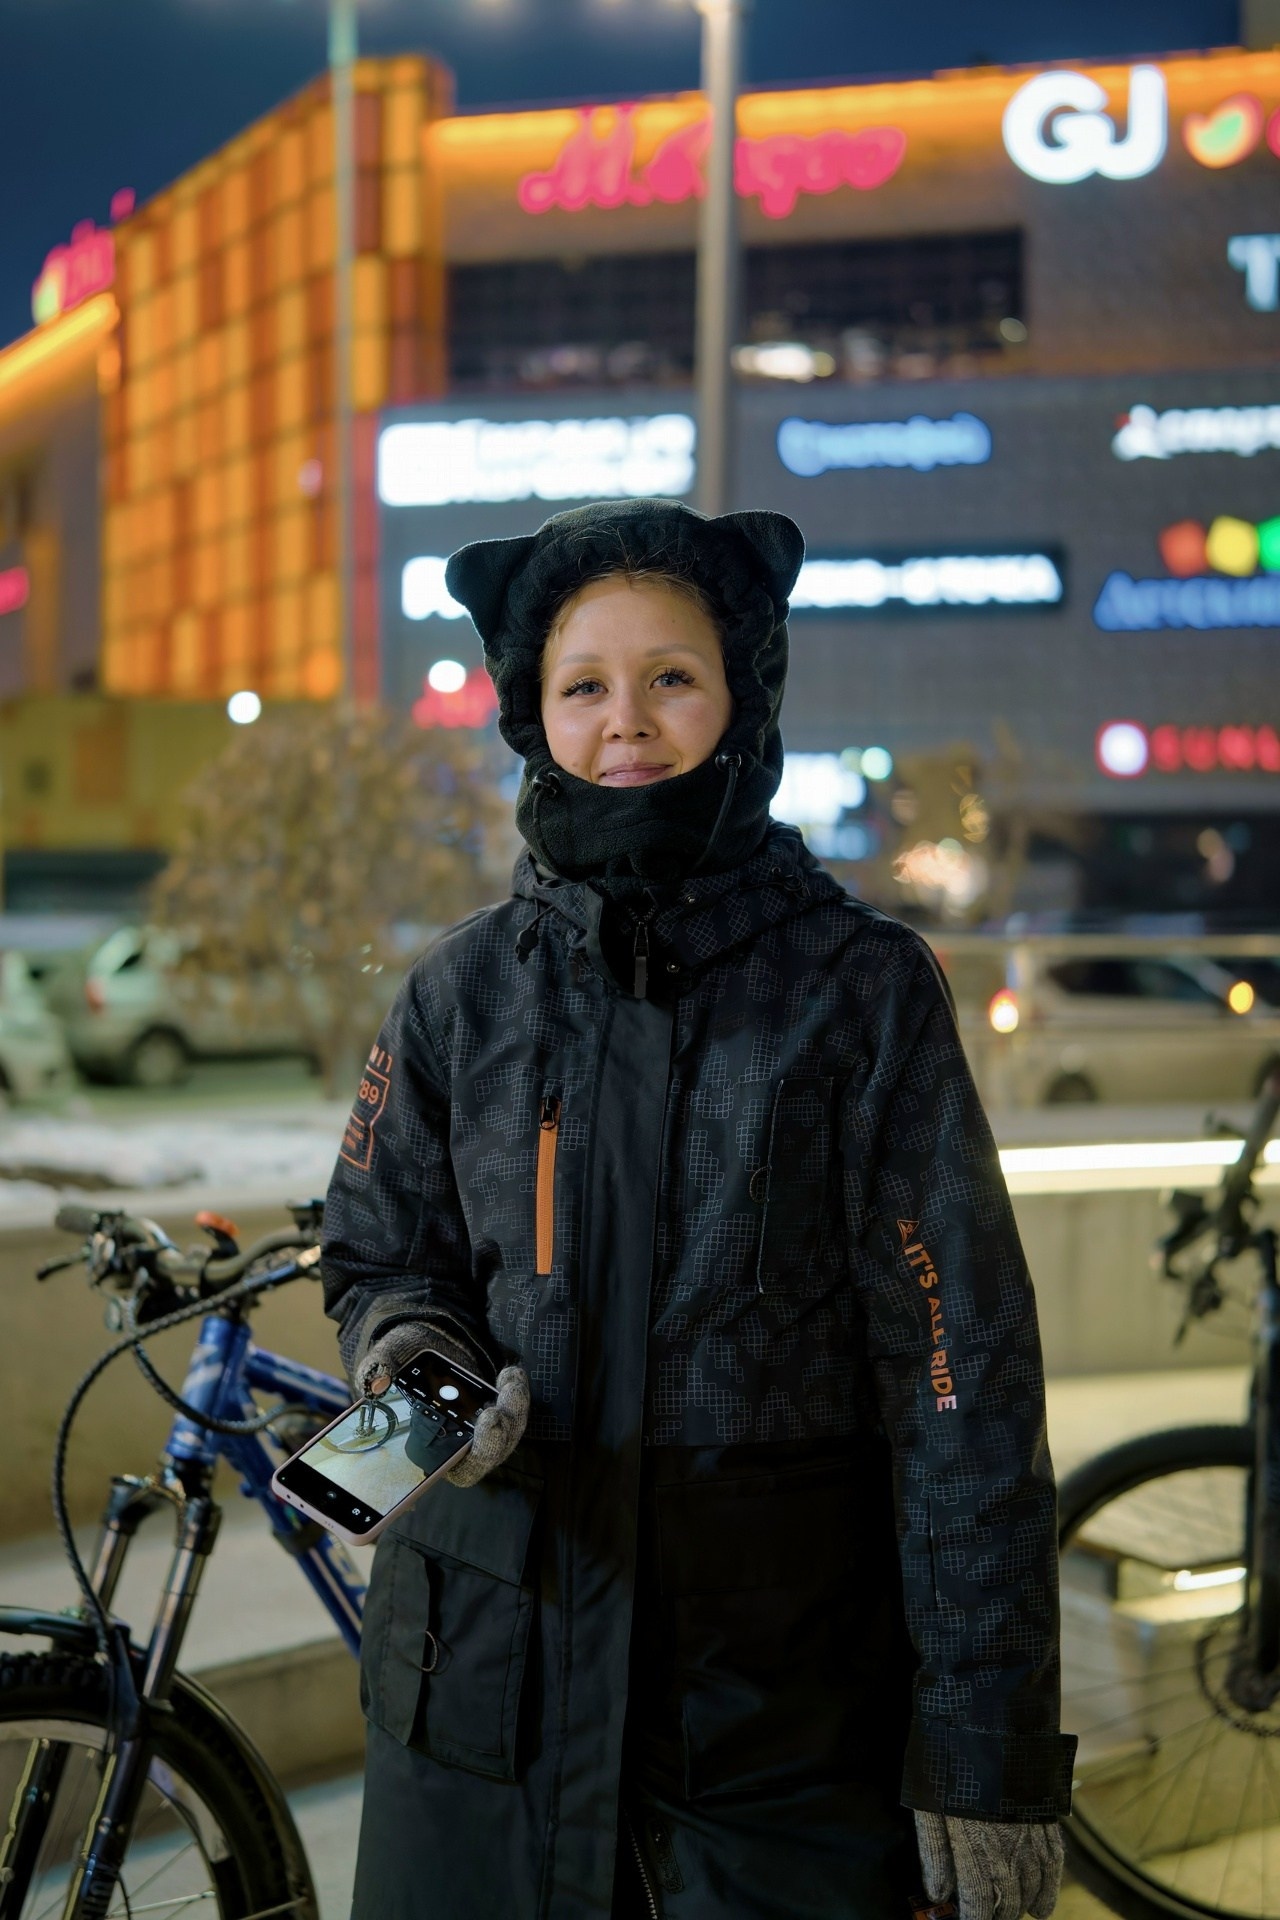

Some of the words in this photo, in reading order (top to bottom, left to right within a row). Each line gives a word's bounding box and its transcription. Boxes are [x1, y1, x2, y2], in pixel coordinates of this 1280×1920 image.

[1002, 63, 1167, 184] GJ
[904, 1242, 939, 1290] IT'S
[927, 1297, 945, 1346] ALL
[930, 1349, 957, 1412] RIDE
